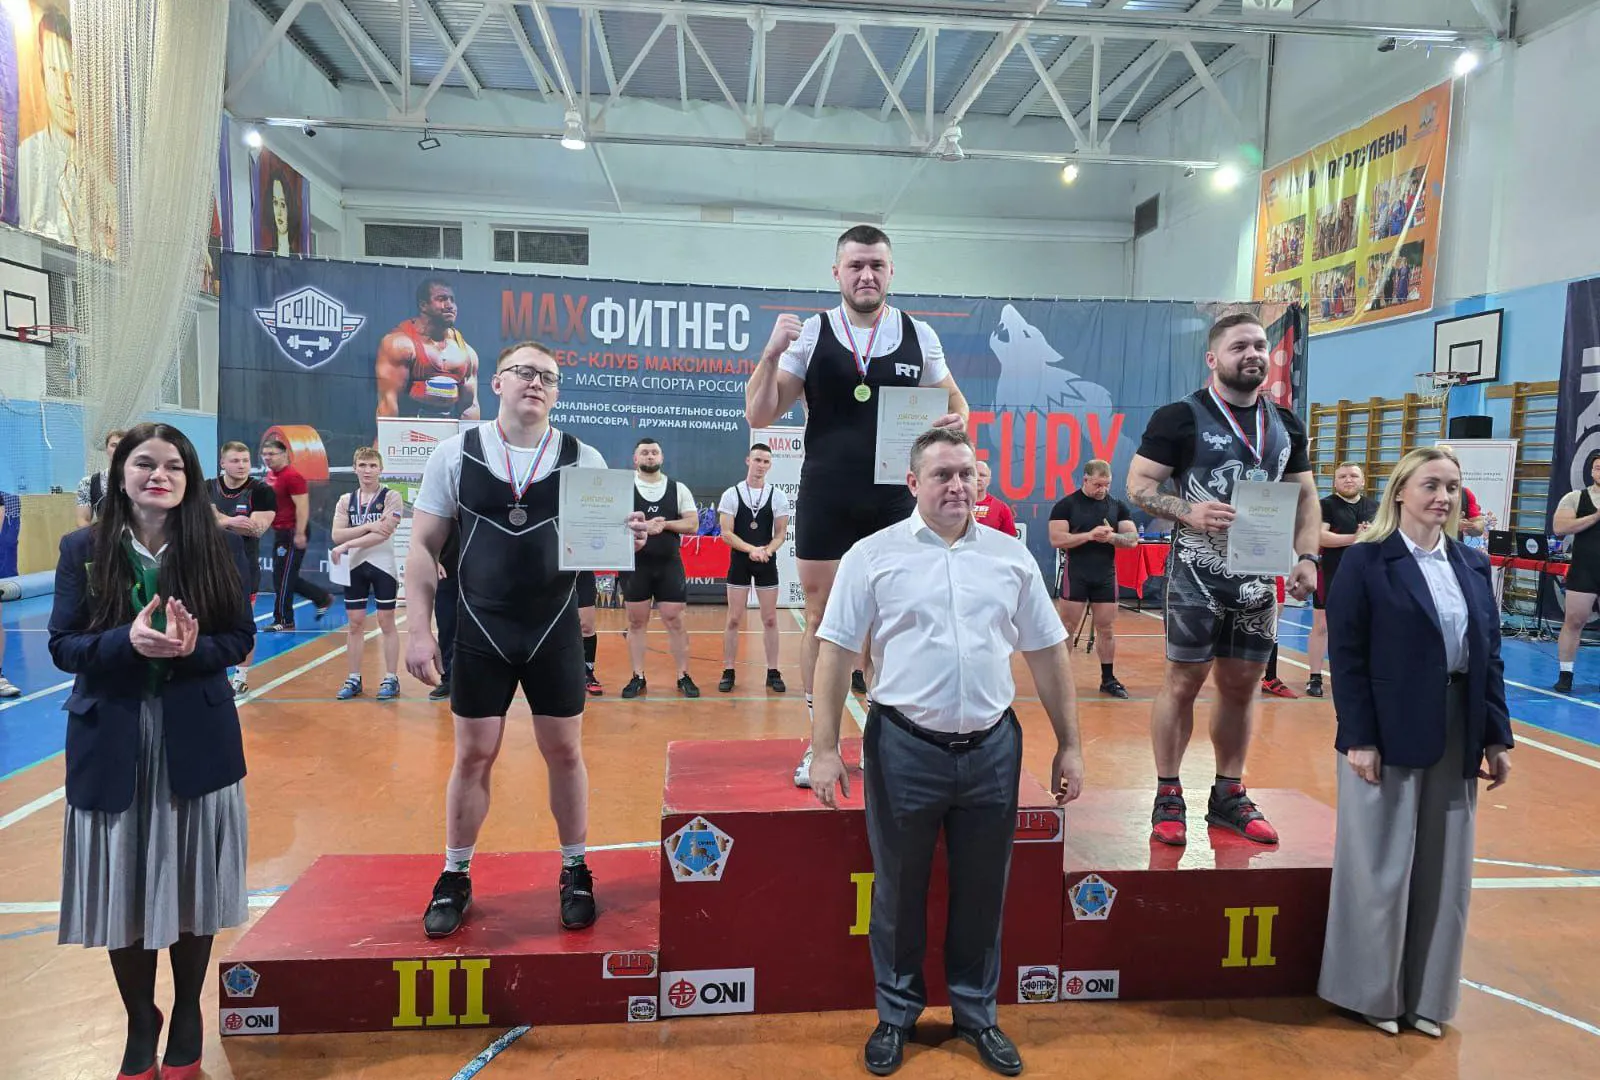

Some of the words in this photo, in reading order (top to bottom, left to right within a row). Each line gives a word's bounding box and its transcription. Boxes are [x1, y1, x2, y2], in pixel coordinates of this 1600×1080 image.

[575, 373, 639, 389] МАСТЕРА
[641, 376, 696, 391] СПОРТА
[698, 379, 748, 393] РОССИ
[611, 404, 714, 417] СОРЕВНОВАТЕЛЬНОЕ
[568, 415, 630, 426] АТМОСФЕРА
[638, 417, 688, 429] ДРУЖНАЯ
[688, 420, 739, 432] КОМАНДА
[1221, 906, 1279, 967] II
[392, 958, 491, 1027] III
[700, 981, 746, 1004] ONI
[1085, 978, 1114, 993] ONI
[245, 1014, 274, 1028] ONI
